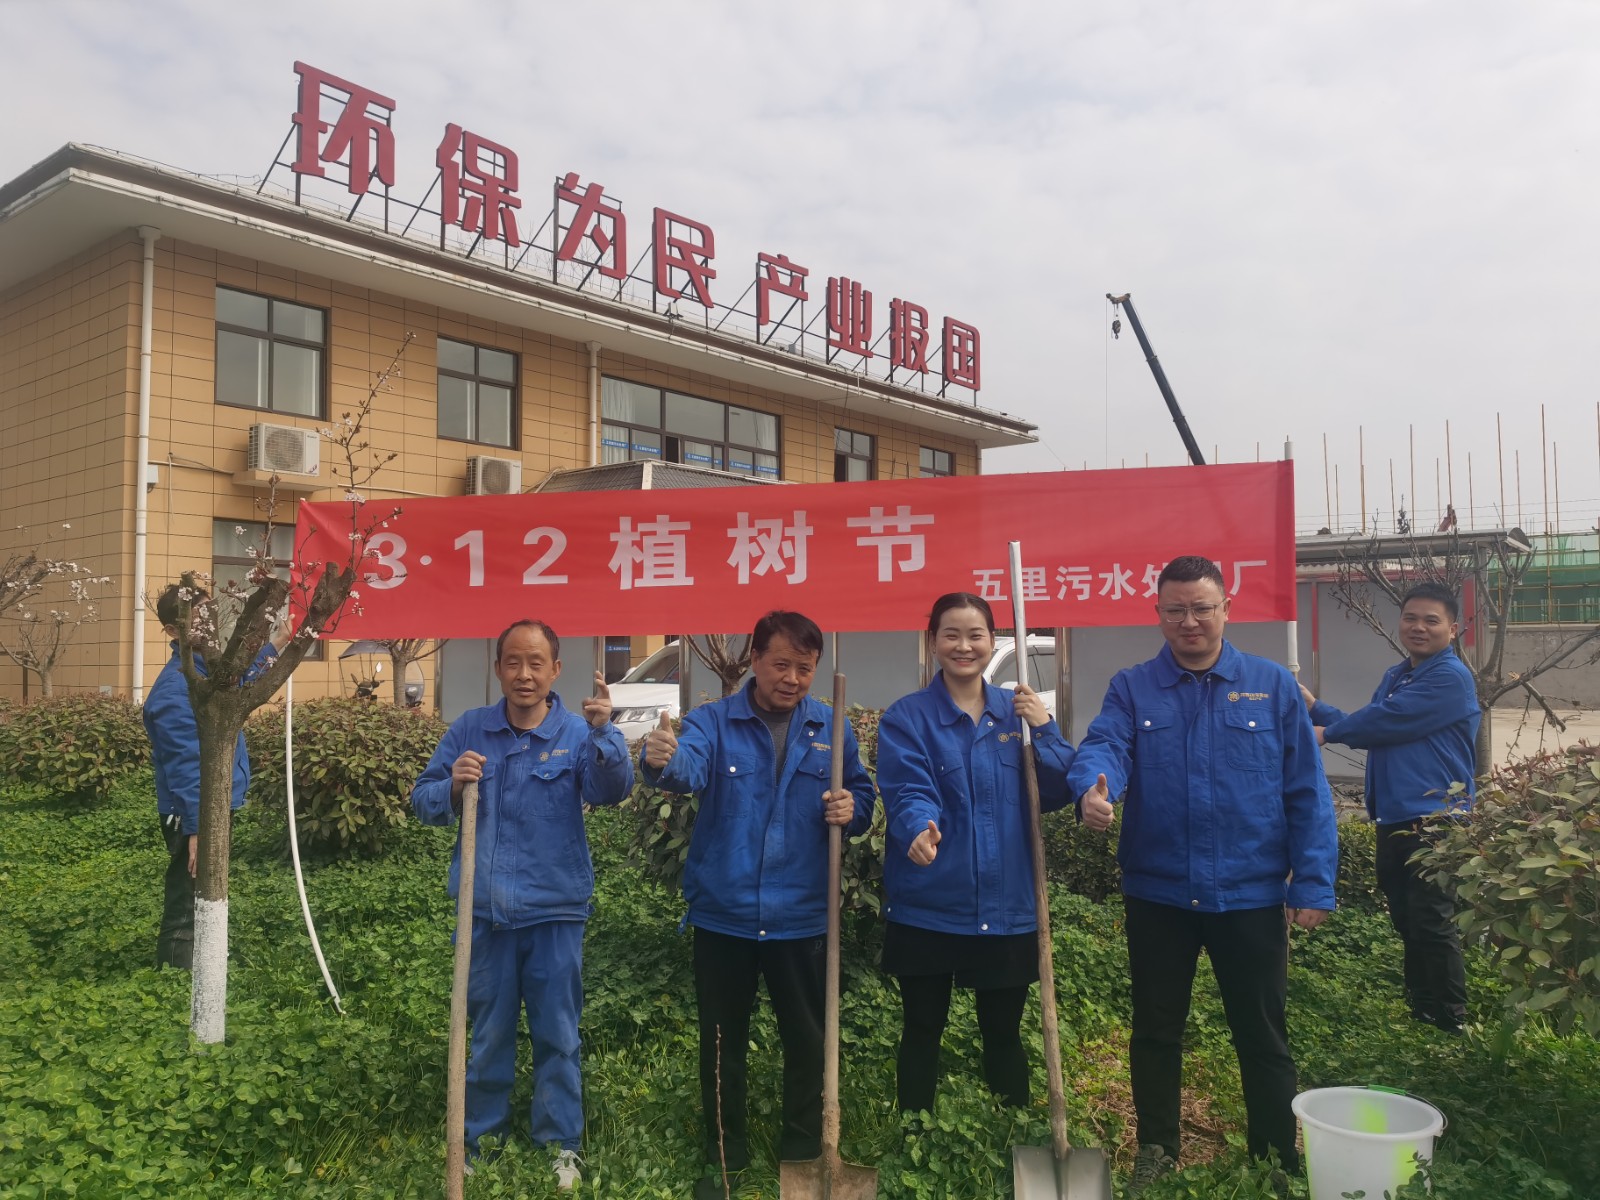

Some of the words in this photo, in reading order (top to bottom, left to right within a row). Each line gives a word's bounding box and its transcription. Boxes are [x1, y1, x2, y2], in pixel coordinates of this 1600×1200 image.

[293, 61, 717, 309] 环保为民
[757, 252, 981, 391] 产业报国
